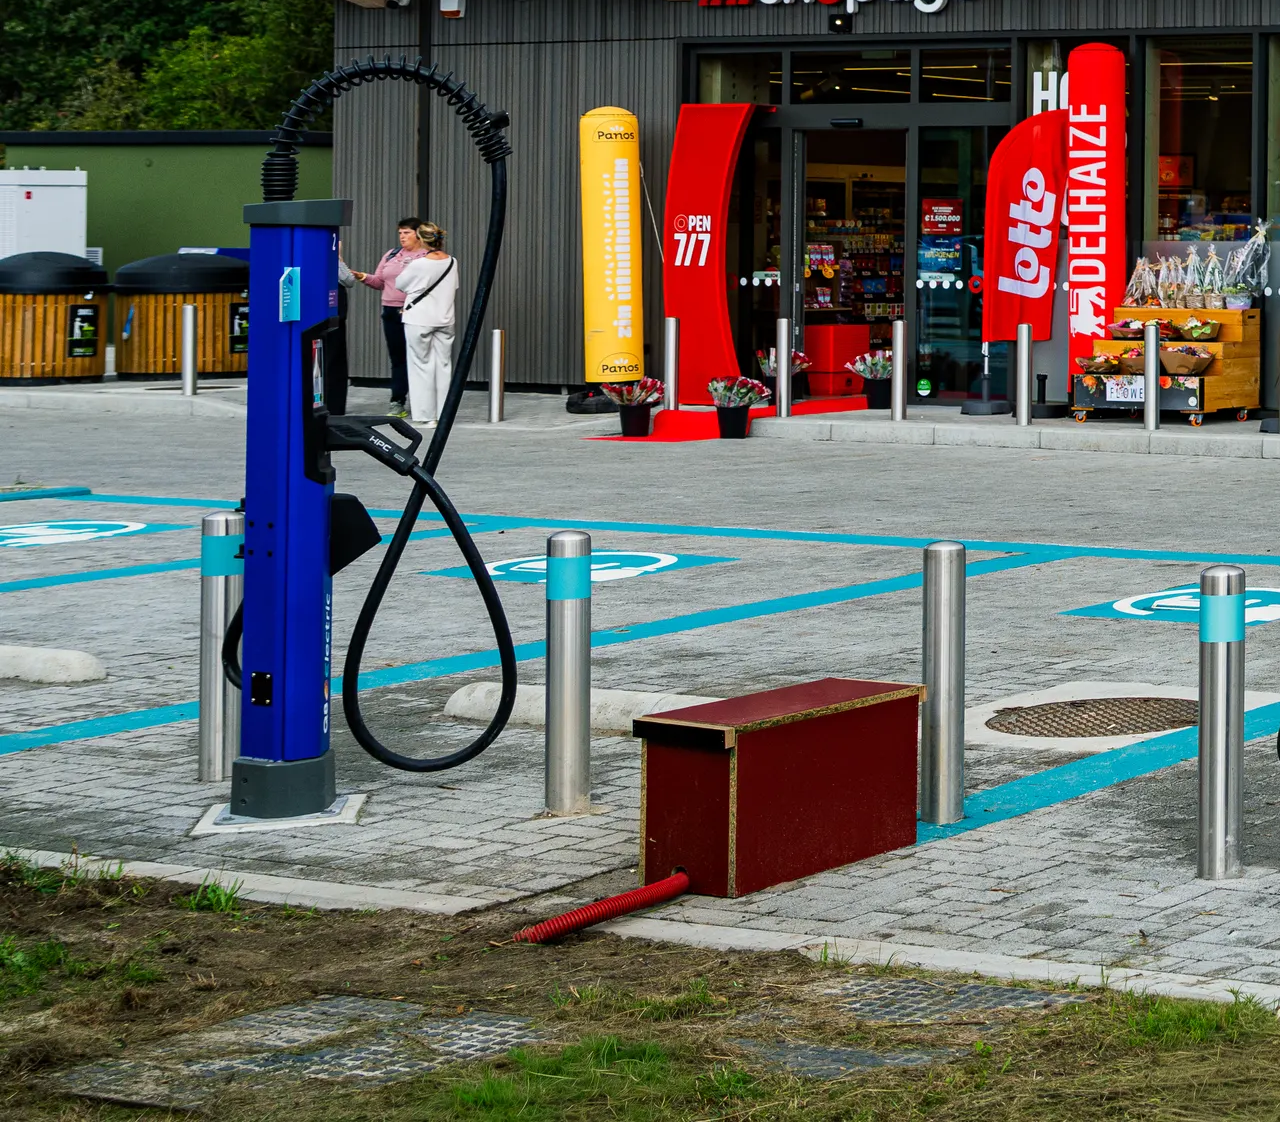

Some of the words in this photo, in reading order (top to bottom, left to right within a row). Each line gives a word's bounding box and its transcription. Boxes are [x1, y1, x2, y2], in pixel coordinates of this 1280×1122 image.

[597, 131, 635, 140] Panos
[1069, 104, 1106, 282] DELHAIZE
[998, 167, 1057, 298] Lotto
[673, 233, 711, 267] 7/7
[602, 363, 639, 374] Panos
[1110, 387, 1144, 399] FLOWE
[369, 435, 392, 452] HPC
